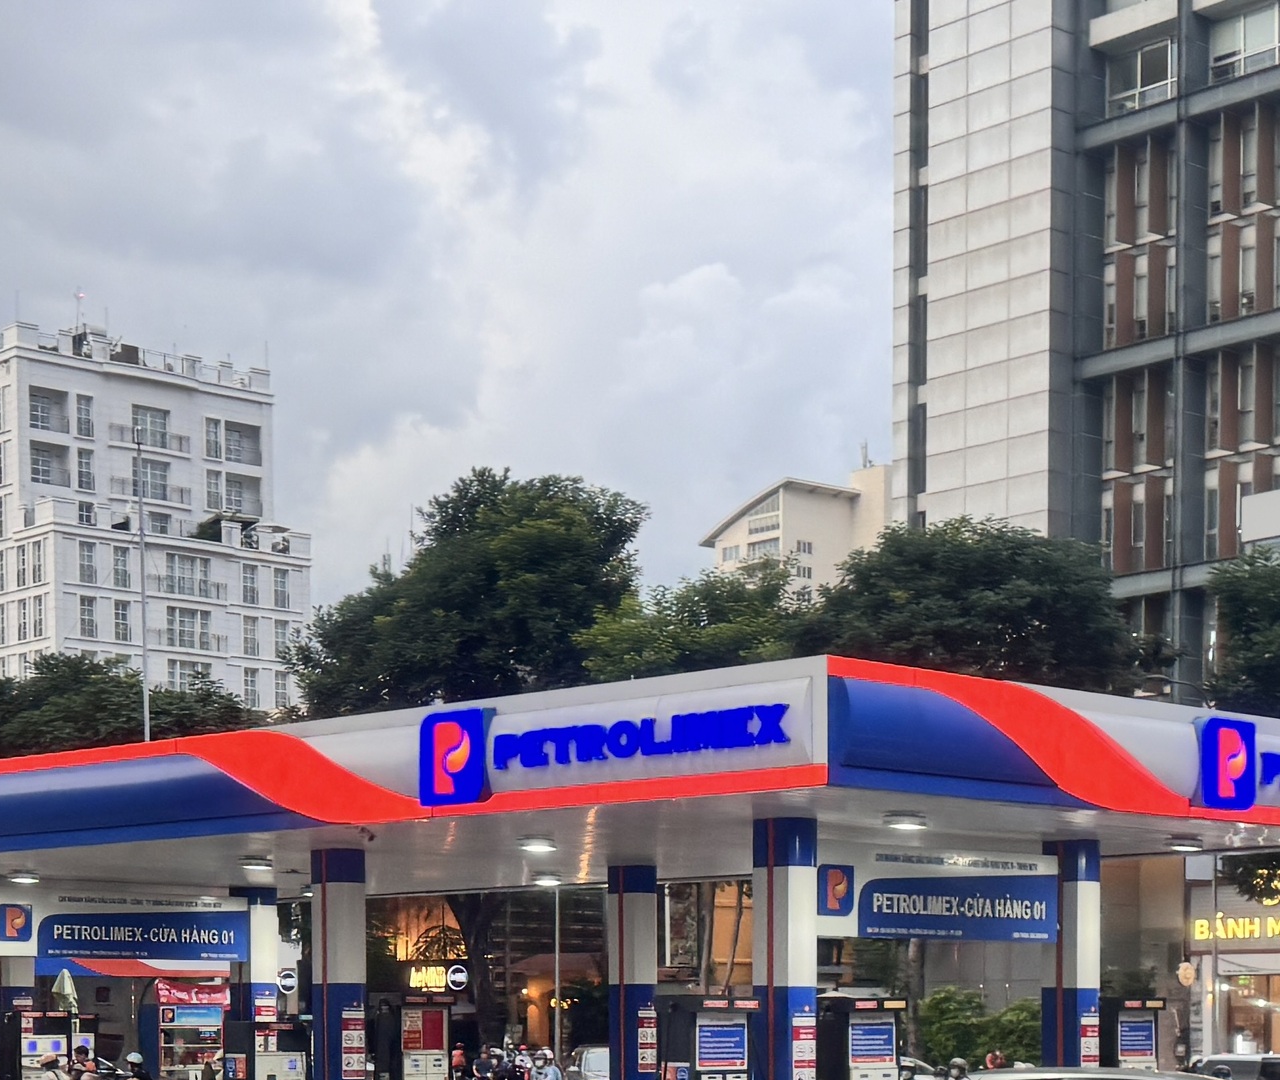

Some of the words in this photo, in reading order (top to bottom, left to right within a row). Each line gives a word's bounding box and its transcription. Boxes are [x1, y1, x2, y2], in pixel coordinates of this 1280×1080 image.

[493, 703, 791, 770] PETROLIMEX
[995, 894, 1032, 920] HÀNG
[1033, 901, 1047, 920] 01
[181, 924, 219, 944] HÀNG
[221, 930, 235, 944] 01
[1194, 911, 1261, 940] BÁNH
